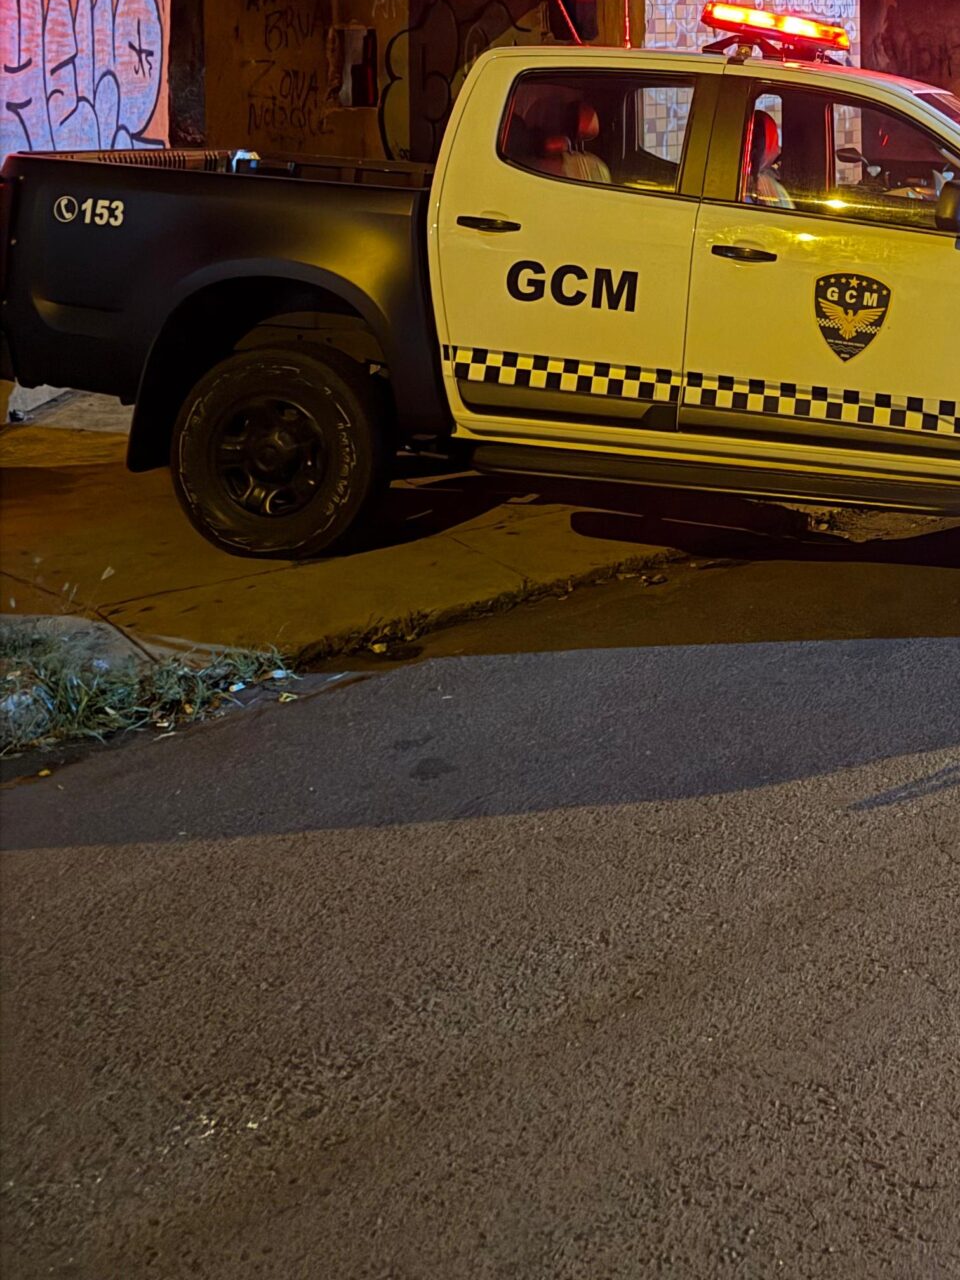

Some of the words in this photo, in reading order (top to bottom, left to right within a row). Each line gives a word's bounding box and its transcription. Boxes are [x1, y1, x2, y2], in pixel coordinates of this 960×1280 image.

[81, 198, 125, 227] 153
[506, 260, 639, 312] GCM
[826, 287, 878, 307] GCM
